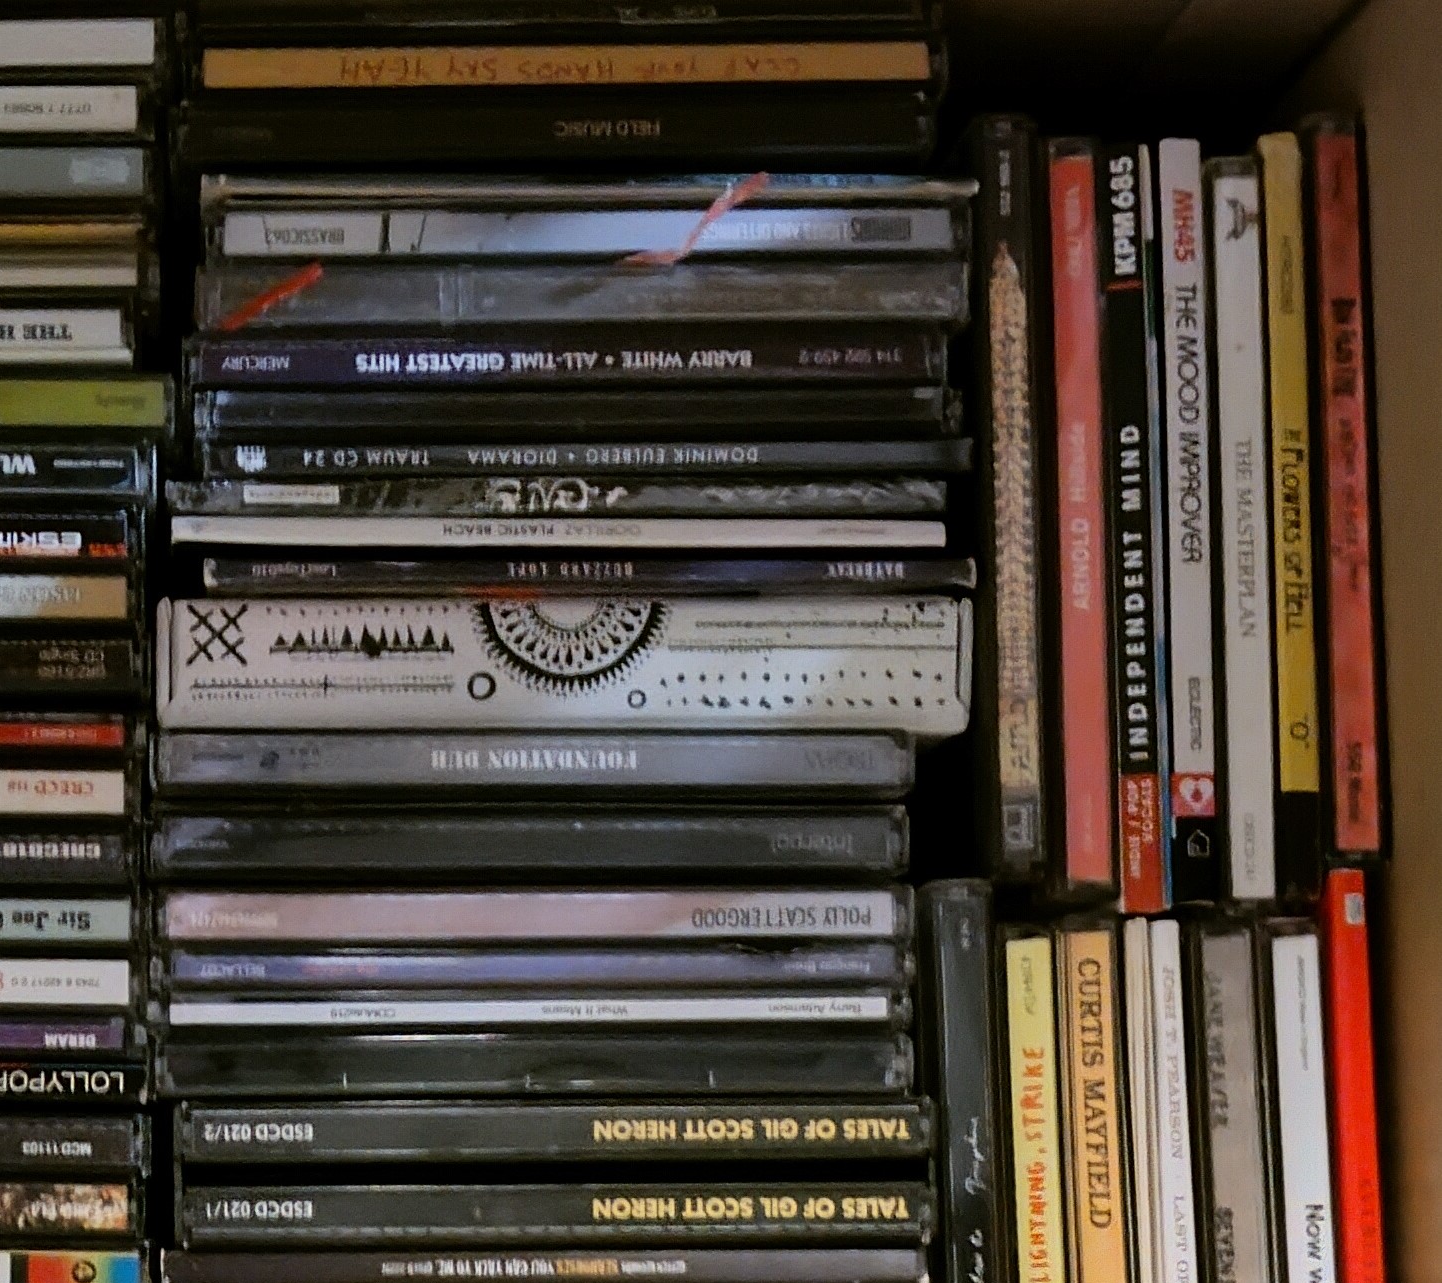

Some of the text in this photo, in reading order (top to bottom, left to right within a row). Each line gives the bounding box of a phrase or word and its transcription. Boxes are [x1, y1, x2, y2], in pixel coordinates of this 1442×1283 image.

[1174, 189, 1193, 263] MH45
[22, 323, 73, 342] THE
[1176, 284, 1198, 329] THE
[221, 350, 752, 372] BARRY WHITE ALL-TIME GREATEST HITS MERCURY
[1176, 336, 1201, 424] MOOD
[1178, 432, 1202, 564] IMPROVER
[1233, 440, 1258, 638] THE MASTERPLAN
[1120, 424, 1150, 761] INDEPENDENT MIND
[691, 905, 872, 929] POLLY SCATTERGOOD
[1076, 958, 1106, 1070] CURTIS
[592, 1117, 909, 1141] TALES OF GIL SCOTT HERON
[1082, 1077, 1113, 1230] MAYFIELD
[1303, 1203, 1328, 1258] Now
